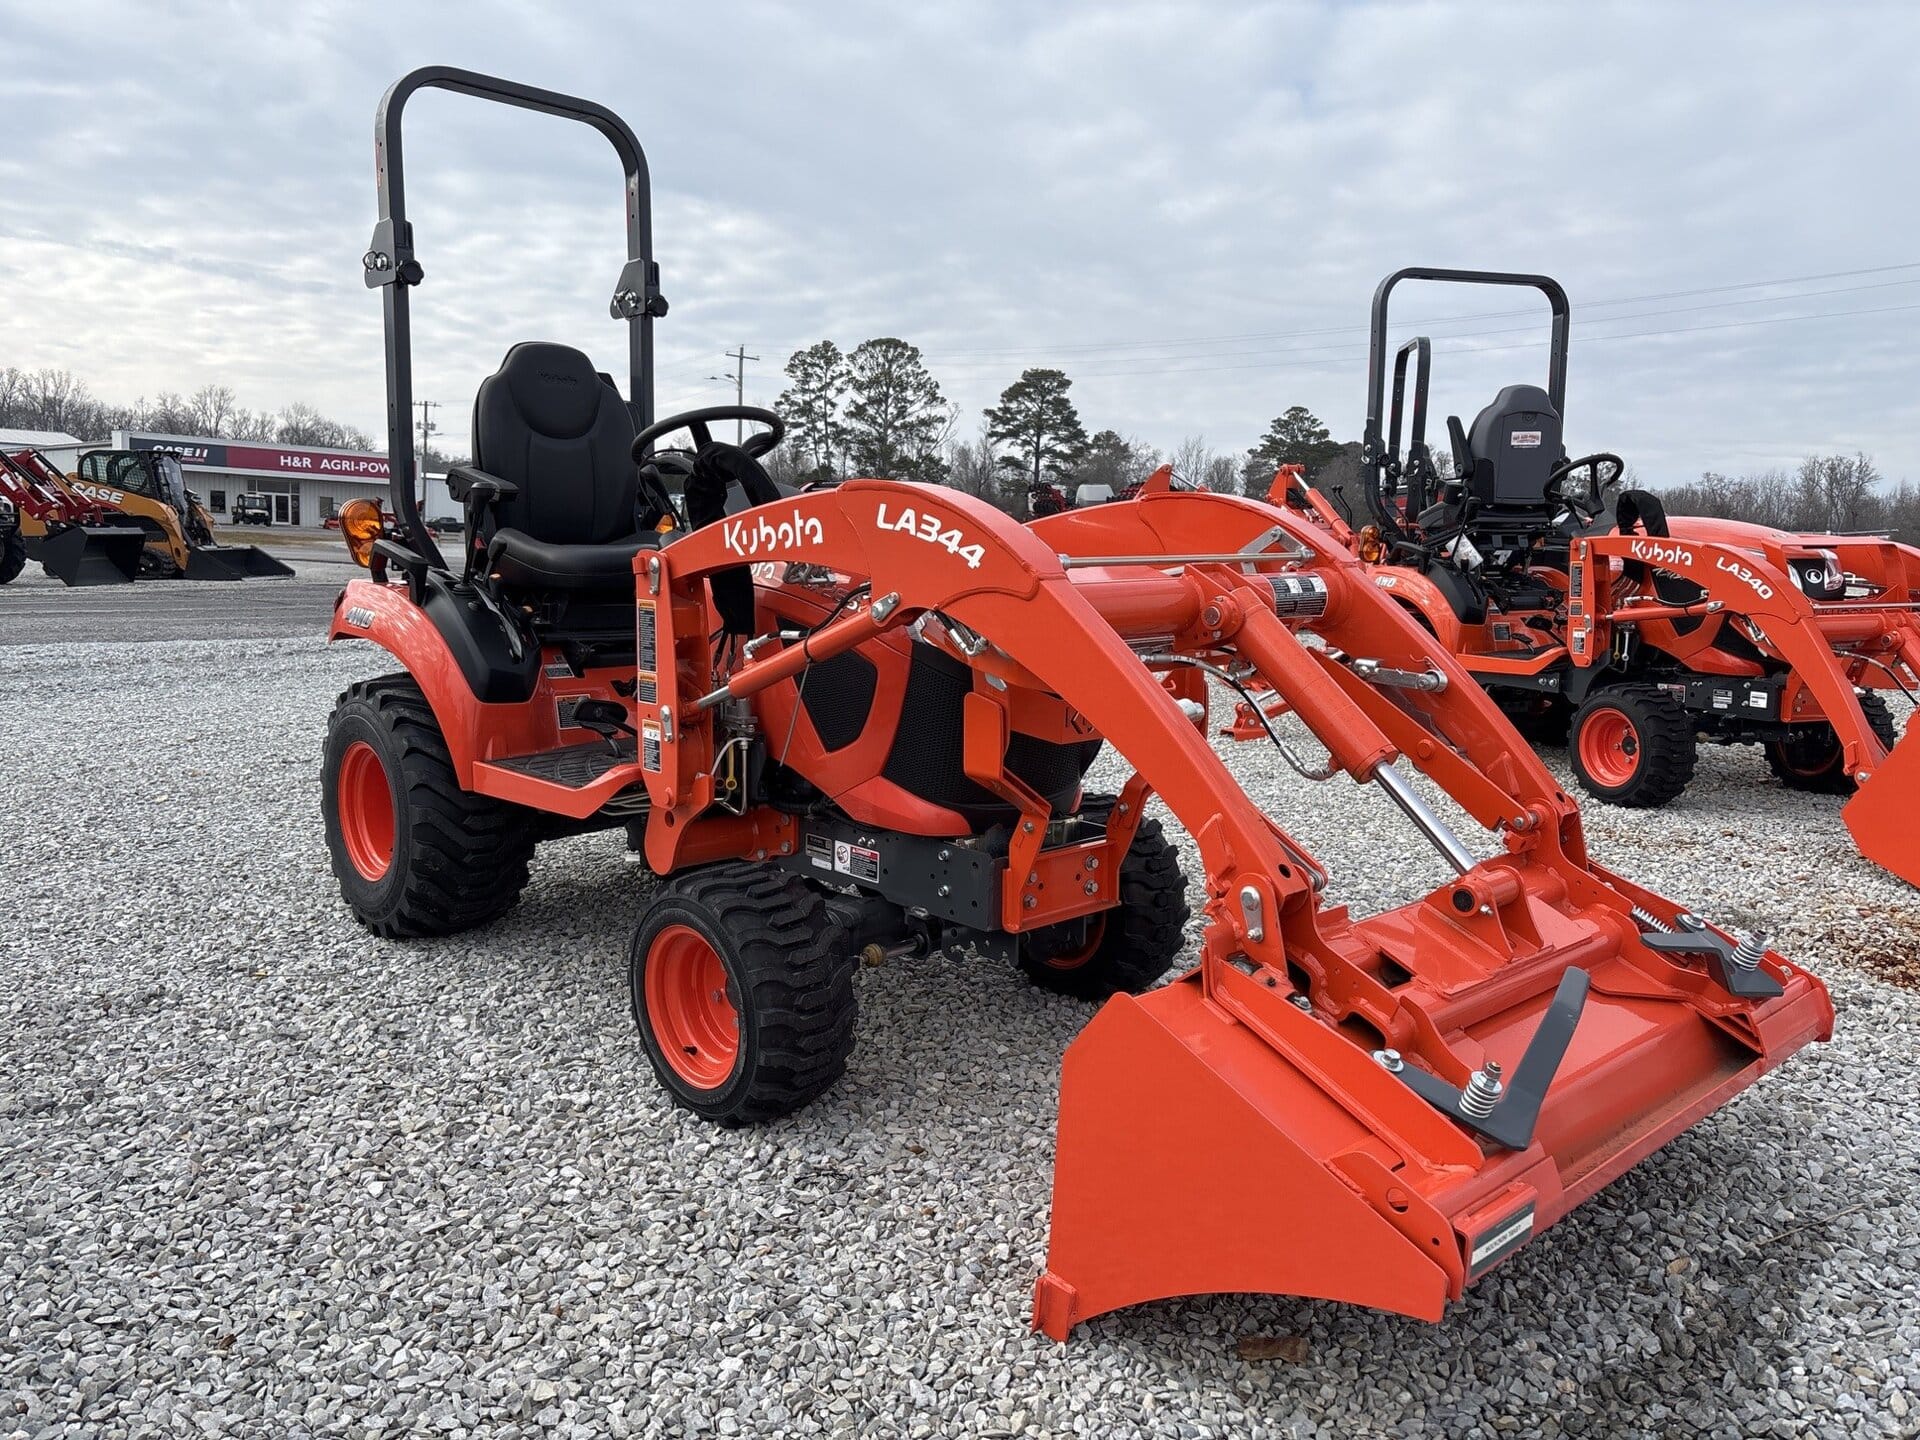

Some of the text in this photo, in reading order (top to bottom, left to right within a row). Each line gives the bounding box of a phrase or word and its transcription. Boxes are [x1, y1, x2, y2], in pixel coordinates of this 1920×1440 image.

[280, 455, 312, 469] H&R
[723, 509, 824, 557] Kubota
[876, 503, 986, 570] LA344
[1631, 540, 1694, 567] Kubota
[1716, 556, 1774, 600] LA340
